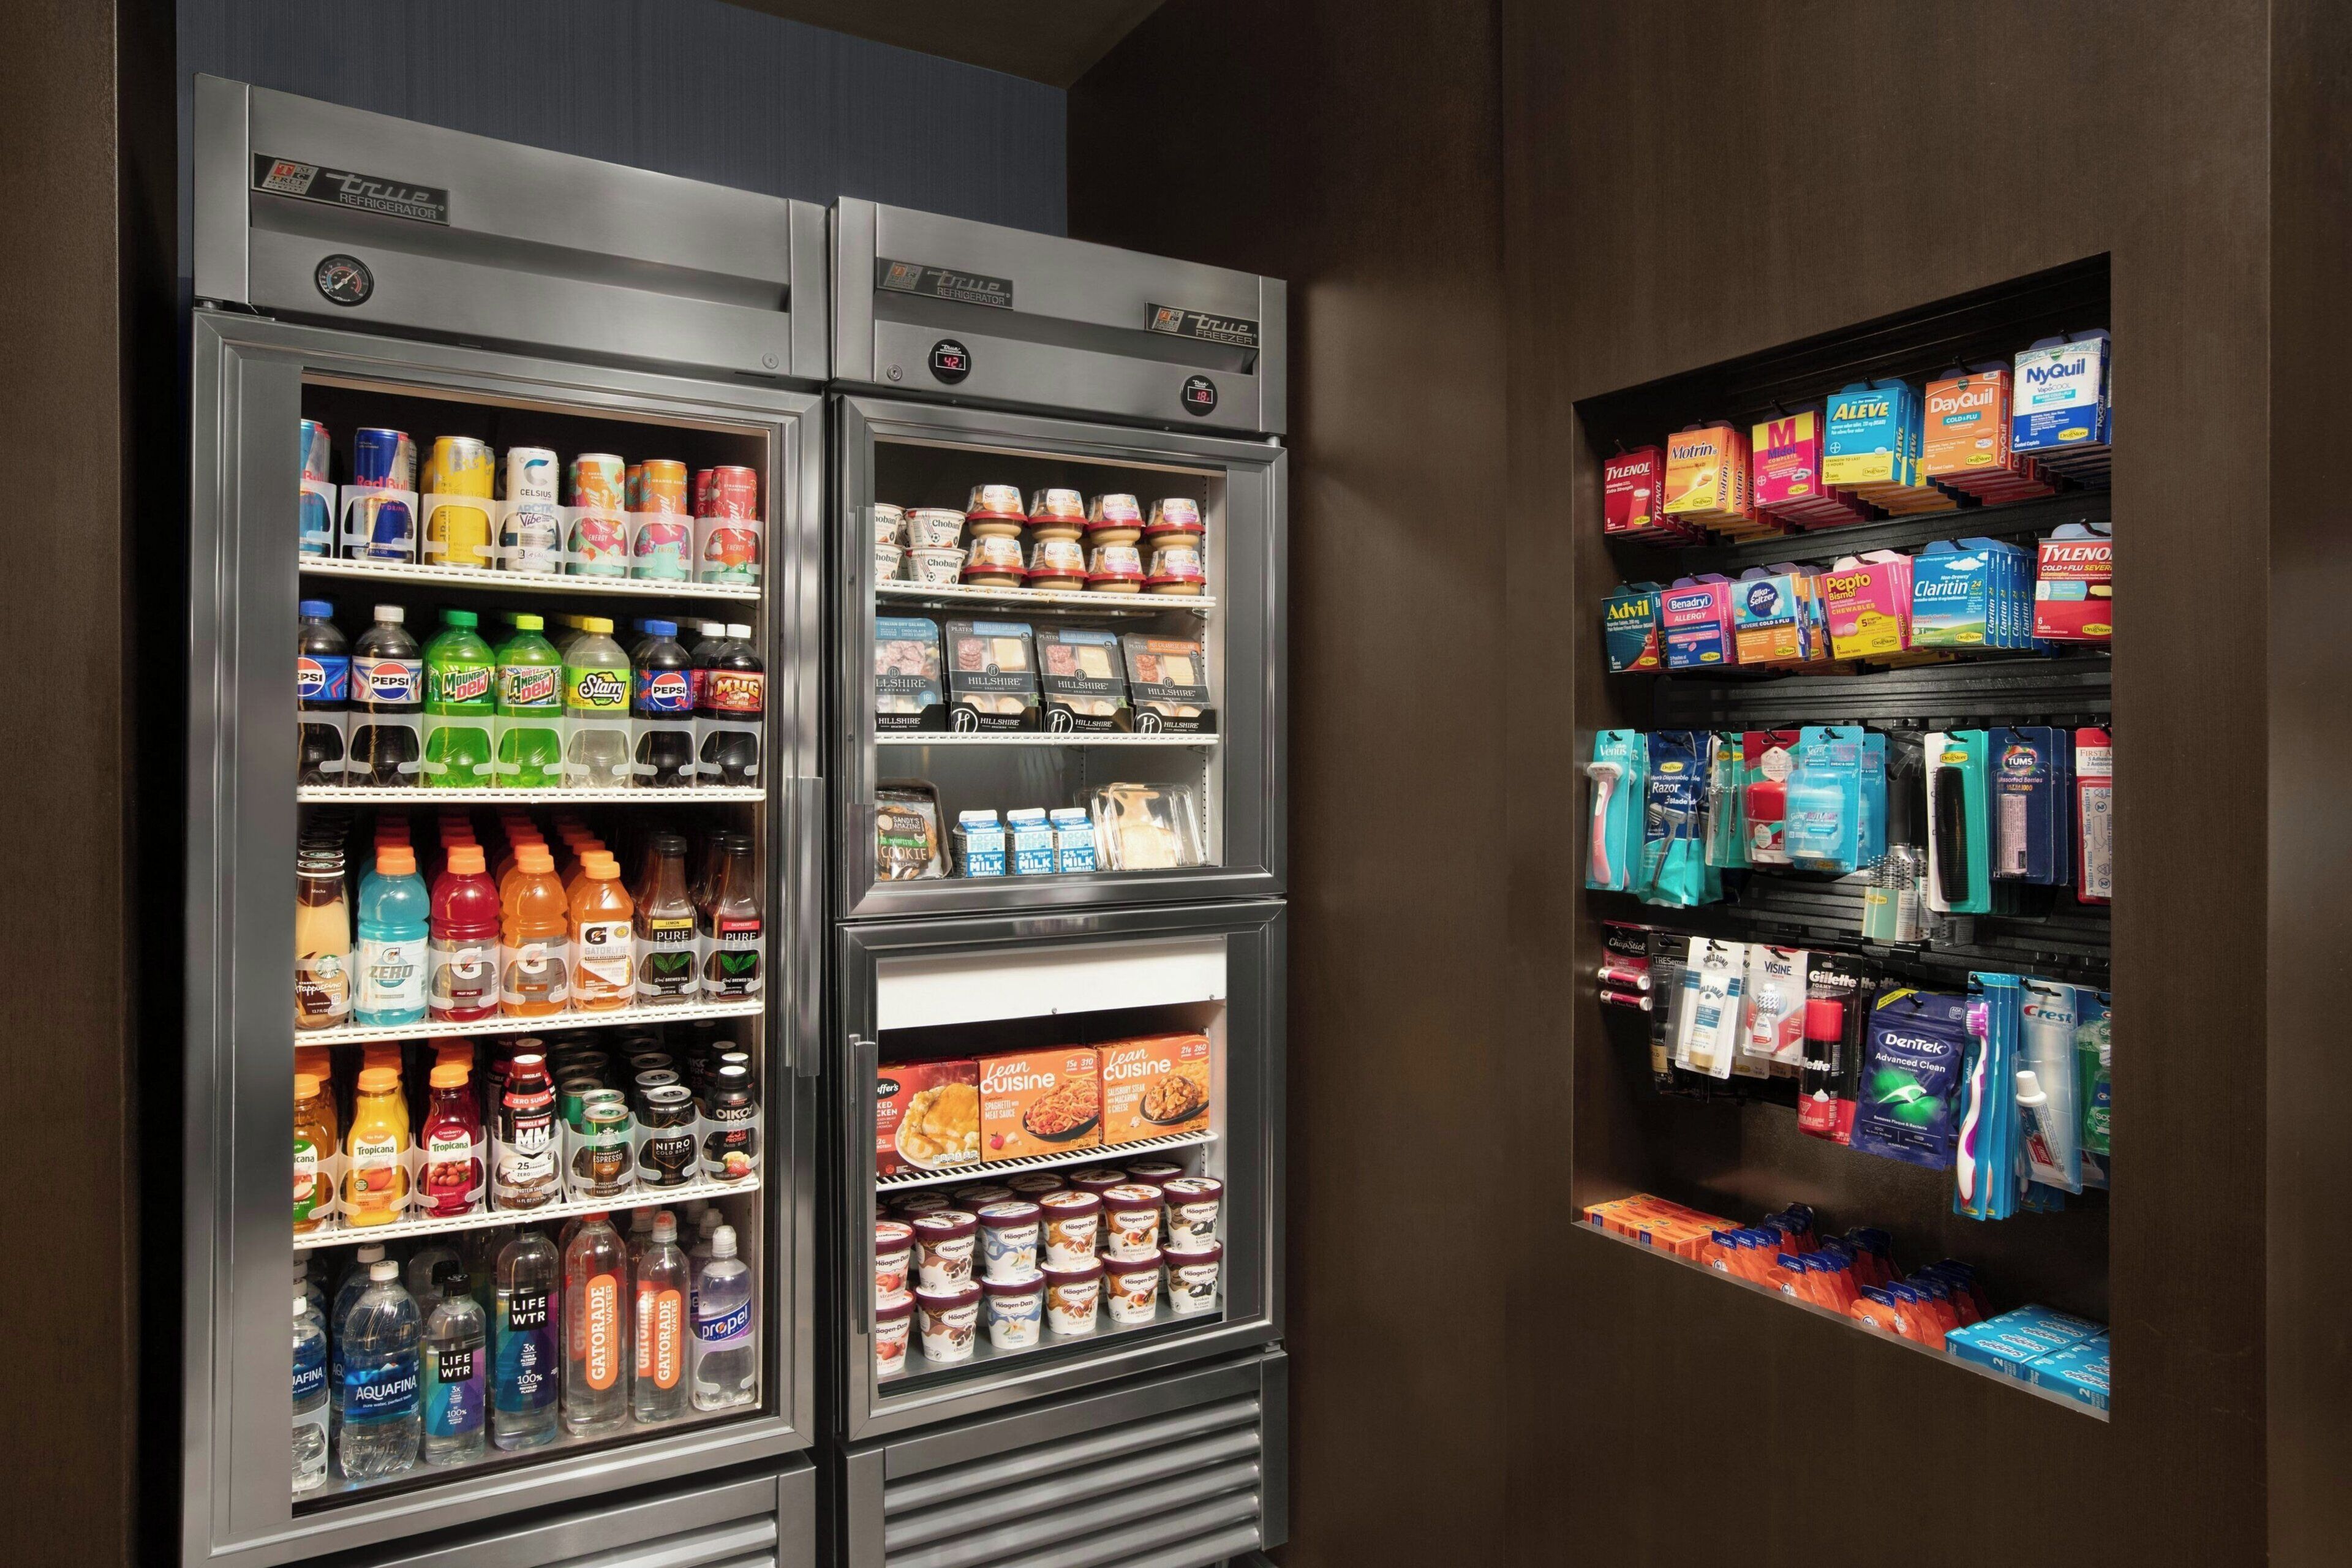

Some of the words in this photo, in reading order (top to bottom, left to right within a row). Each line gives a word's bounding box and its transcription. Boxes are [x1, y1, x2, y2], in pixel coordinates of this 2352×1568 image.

[340, 193, 437, 219] REFRIGERATOR
[937, 287, 1005, 305] REFRIGERATOR
[1196, 329, 1253, 344] FREEZER
[944, 356, 959, 368] 42
[2026, 358, 2086, 385] NyQuil
[1931, 388, 1993, 414] DayQuil
[1832, 401, 1890, 421] ALEVE
[2060, 430, 2087, 439] DrugStore
[1670, 442, 1713, 460] Motrin
[1768, 443, 1796, 458] Midol
[1768, 453, 1798, 464] COMPLETE
[1607, 461, 1651, 481] TYLENOL
[1718, 462, 1728, 503] Motrin
[521, 489, 552, 498] CELSIUS
[520, 513, 541, 527] Vibe
[932, 519, 960, 530] Chobani
[927, 558, 958, 568] Chobani
[1826, 573, 1871, 592] Pepto
[1915, 580, 1968, 597] Claritin
[1751, 588, 1770, 598] Alka-
[1828, 589, 1856, 601] Bismol
[1671, 596, 1708, 609] Benadryl
[1750, 592, 1775, 607] Seltzer
[1607, 599, 1649, 620] Advil
[1831, 603, 1875, 615] CHEWABLES
[1674, 612, 1706, 622] ALLERGY
[371, 676, 409, 685] PEPSI
[968, 677, 1021, 685] HILLSHIRE
[1058, 680, 1109, 690] HILLSHIRE
[583, 674, 625, 703] Starry
[716, 679, 760, 698] MUG
[1148, 688, 1196, 697] HILLSHIRE
[1600, 744, 1627, 756] Venus
[1941, 753, 1968, 762] DrugStore
[2007, 757, 2033, 767] TUMS
[1652, 782, 1681, 793] Razor
[970, 861, 1003, 872] MILK
[1019, 859, 1052, 869] MILK
[1063, 858, 1093, 867] MILK
[657, 930, 689, 940] PURE
[726, 932, 756, 941] PURE
[1608, 938, 1646, 951] ChapStick
[1703, 954, 1715, 964] GOLD
[369, 965, 414, 979] ZERO
[1764, 960, 1792, 976] VISINE
[1809, 970, 1857, 987] Gillette
[2023, 1005, 2073, 1024] Crest
[1885, 1033, 1945, 1054] DenTek
[1109, 1049, 1148, 1069] Lean
[1875, 1052, 1917, 1067] Advanced
[1920, 1058, 1945, 1073] Clean
[987, 1061, 1030, 1082] Lean
[1107, 1085, 1131, 1096] SALISBURY
[1133, 1084, 1145, 1093] STEAK
[530, 1094, 549, 1103] SUGAR
[985, 1100, 1011, 1110] SPAGHETTI
[1112, 1103, 1129, 1113] CHEESE
[985, 1110, 999, 1120] MEAT
[1000, 1109, 1016, 1118] SAUCE
[726, 1119, 747, 1128] PRO
[357, 1145, 394, 1156] Tropicana
[432, 1141, 469, 1152] Tropicana
[656, 1139, 690, 1152] NITRO
[594, 1153, 623, 1163] ESPRESSO
[1120, 1214, 1155, 1223] Häagen-Dazs
[513, 1297, 546, 1311] LIFE
[995, 1300, 1033, 1309] Häagen-Dazs
[512, 1311, 546, 1325] WTR
[703, 1305, 748, 1341] propel
[591, 1285, 605, 1381] GATORADE
[658, 1300, 671, 1381] GATORADE
[442, 1353, 470, 1366] LIFE
[441, 1366, 470, 1378] WTR
[517, 1374, 543, 1384] 100%
[355, 1375, 417, 1401] AQUAFINA
[447, 1409, 467, 1418] 100%
